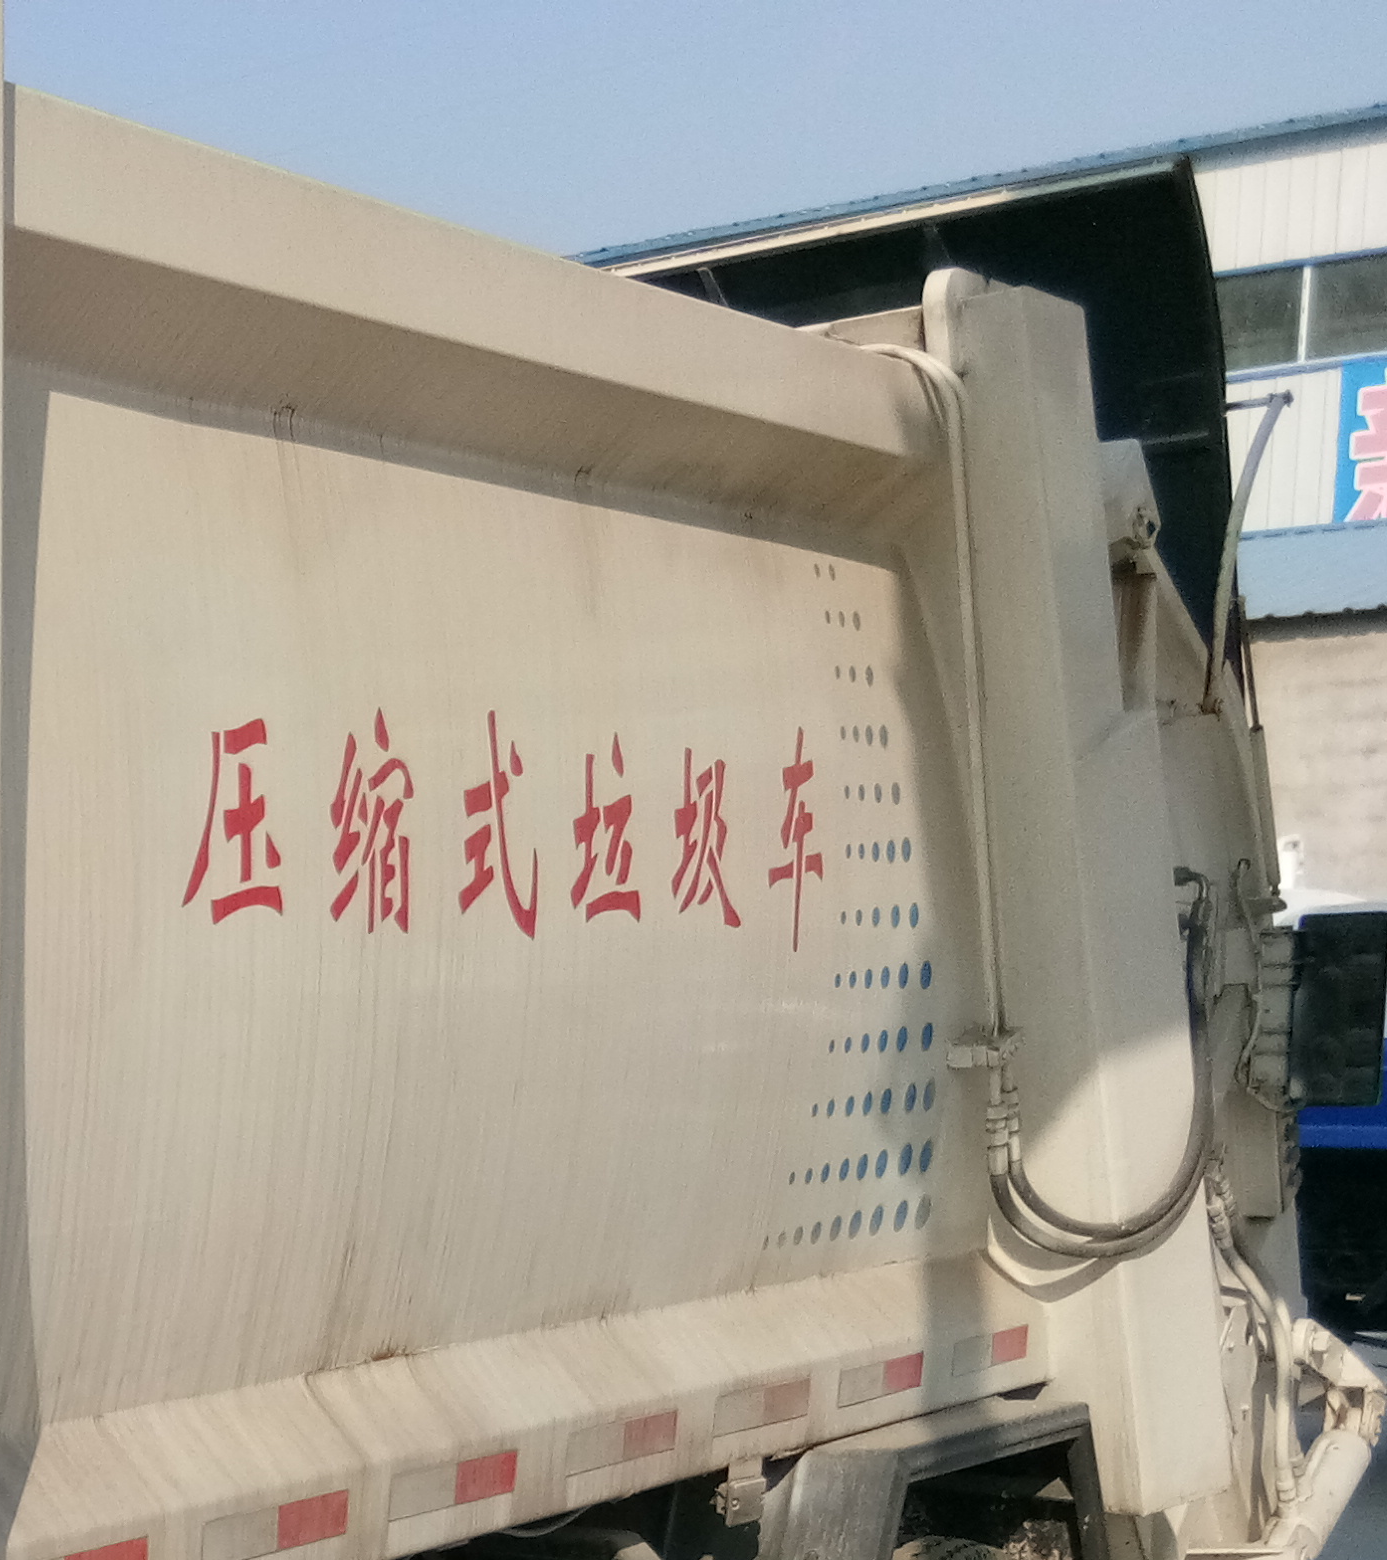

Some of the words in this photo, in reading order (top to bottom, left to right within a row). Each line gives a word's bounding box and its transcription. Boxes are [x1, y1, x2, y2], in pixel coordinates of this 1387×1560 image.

[181, 706, 824, 953] 压缩式垃圾车
